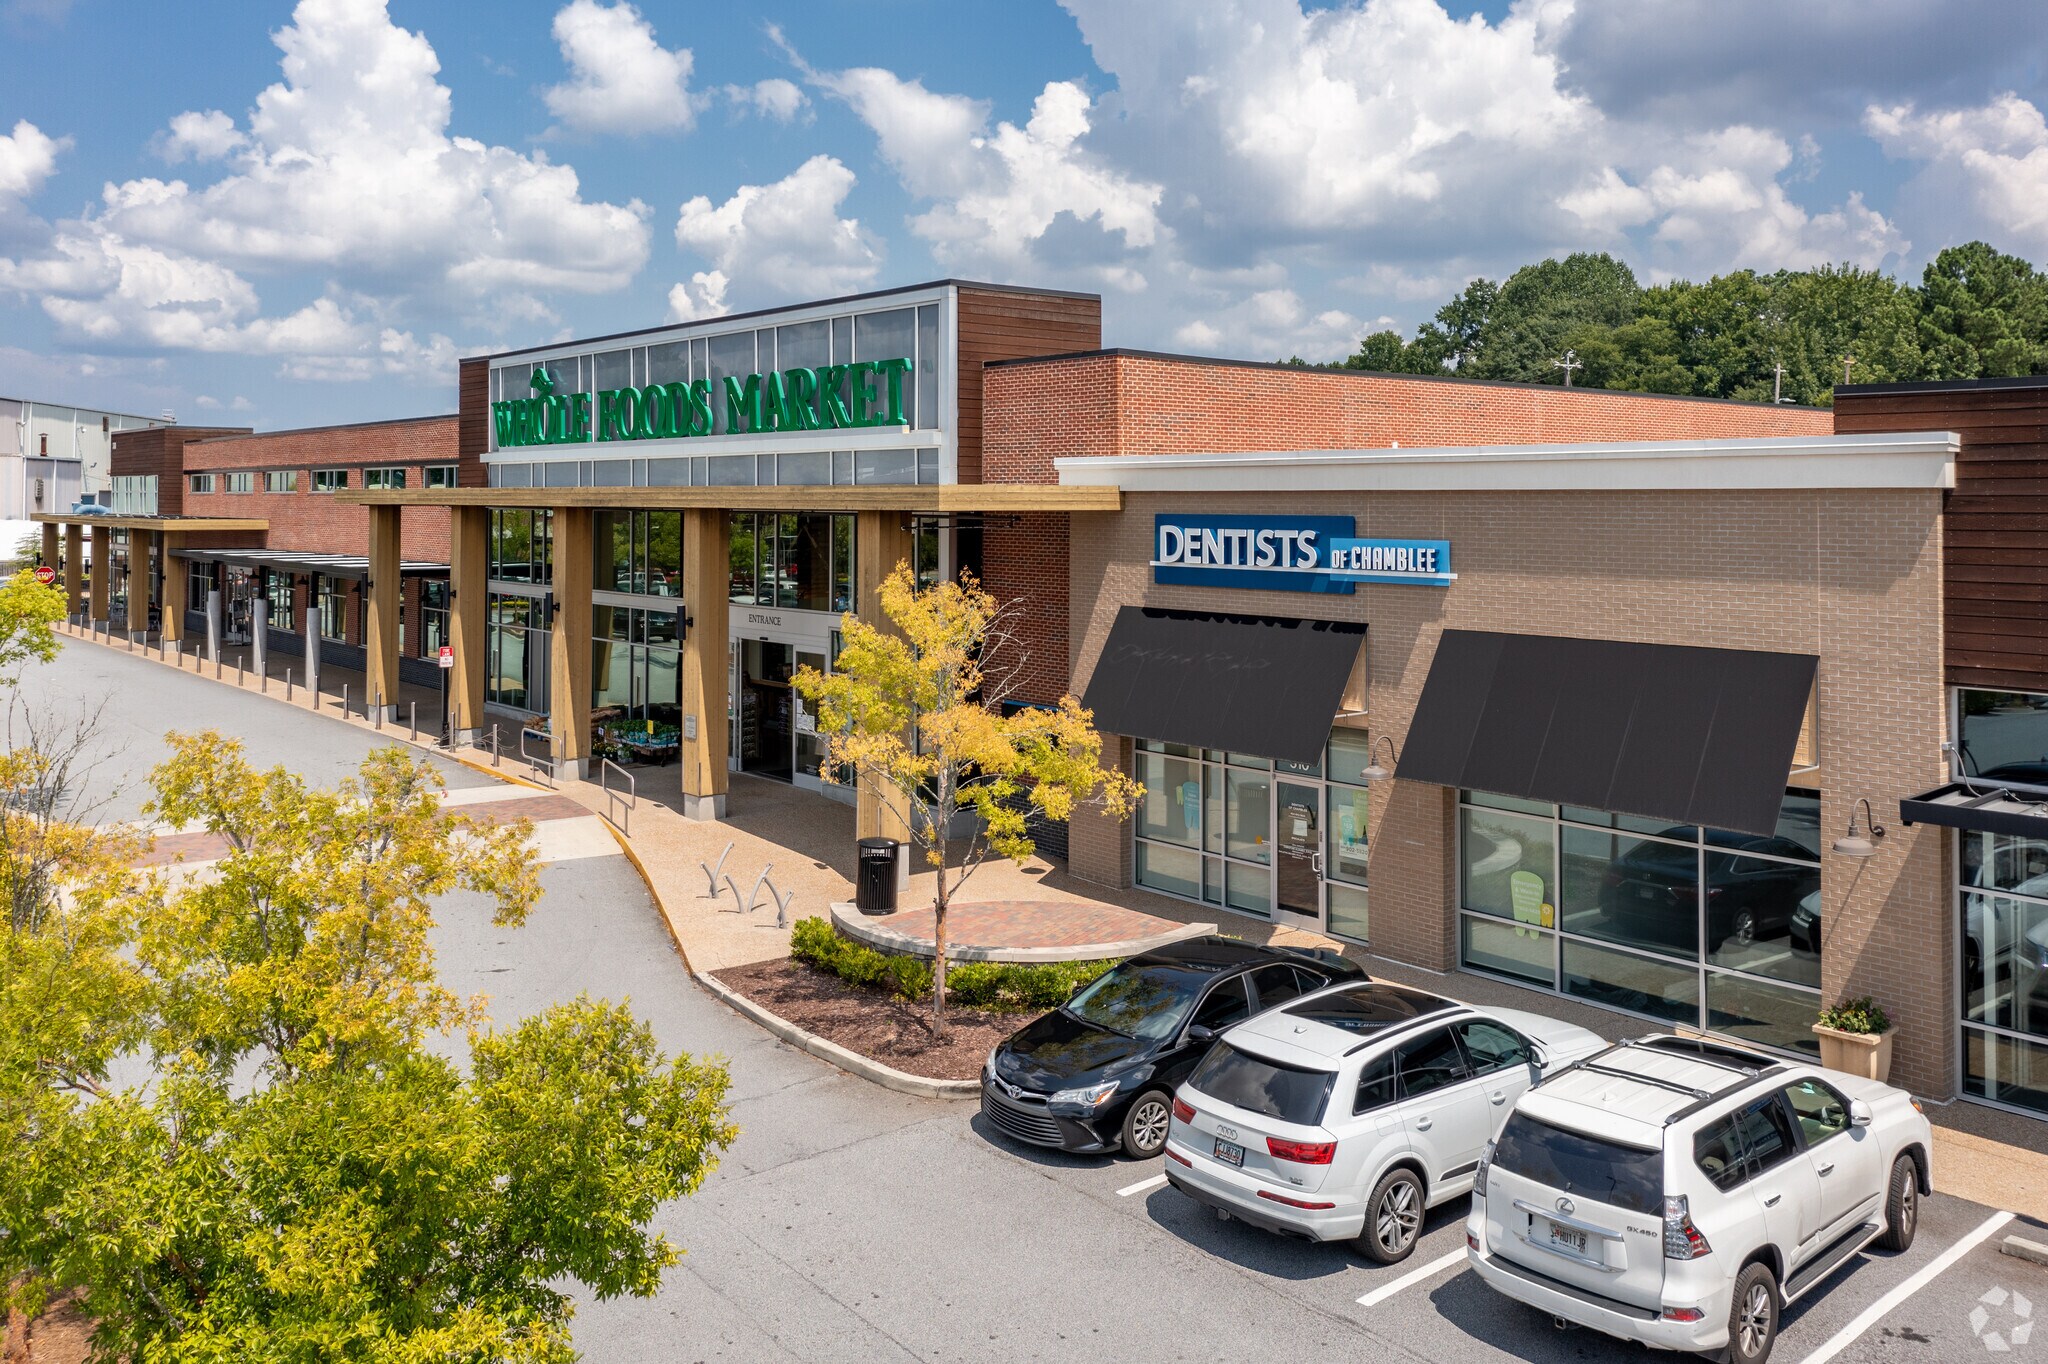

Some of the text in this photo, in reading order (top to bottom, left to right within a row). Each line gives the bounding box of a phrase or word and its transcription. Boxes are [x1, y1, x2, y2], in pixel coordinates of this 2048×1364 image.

[491, 357, 913, 447] WHOLE FOODS MARKET
[1159, 524, 1436, 573] DENTISTS OF CHAMBLEE
[36, 571, 54, 580] STOP
[748, 613, 782, 626] ENTRANCE
